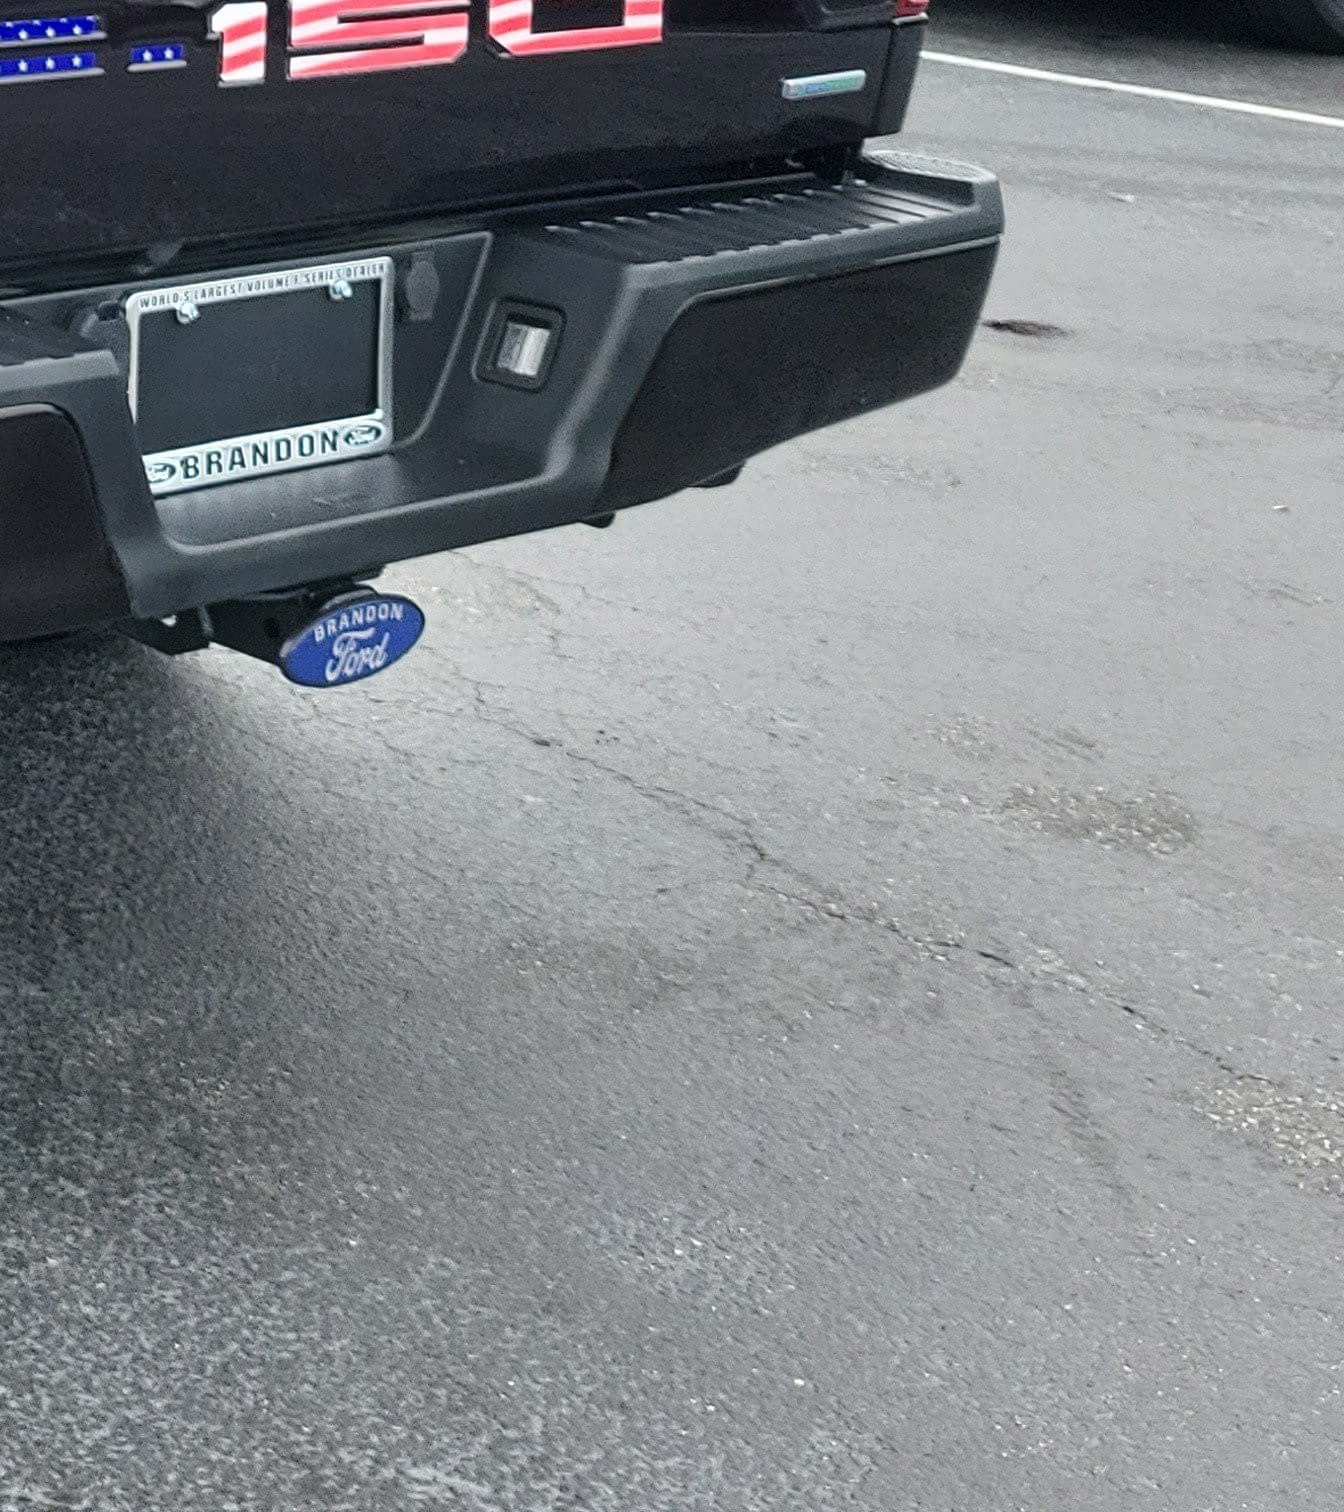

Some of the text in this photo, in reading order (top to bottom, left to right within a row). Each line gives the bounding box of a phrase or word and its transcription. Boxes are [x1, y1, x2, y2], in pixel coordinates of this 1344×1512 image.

[194, 282, 243, 300] LARGEST
[247, 275, 289, 292] VOLUME
[180, 429, 339, 480] BRANDON
[314, 603, 404, 642] BRANDON
[324, 627, 391, 682] Ford
